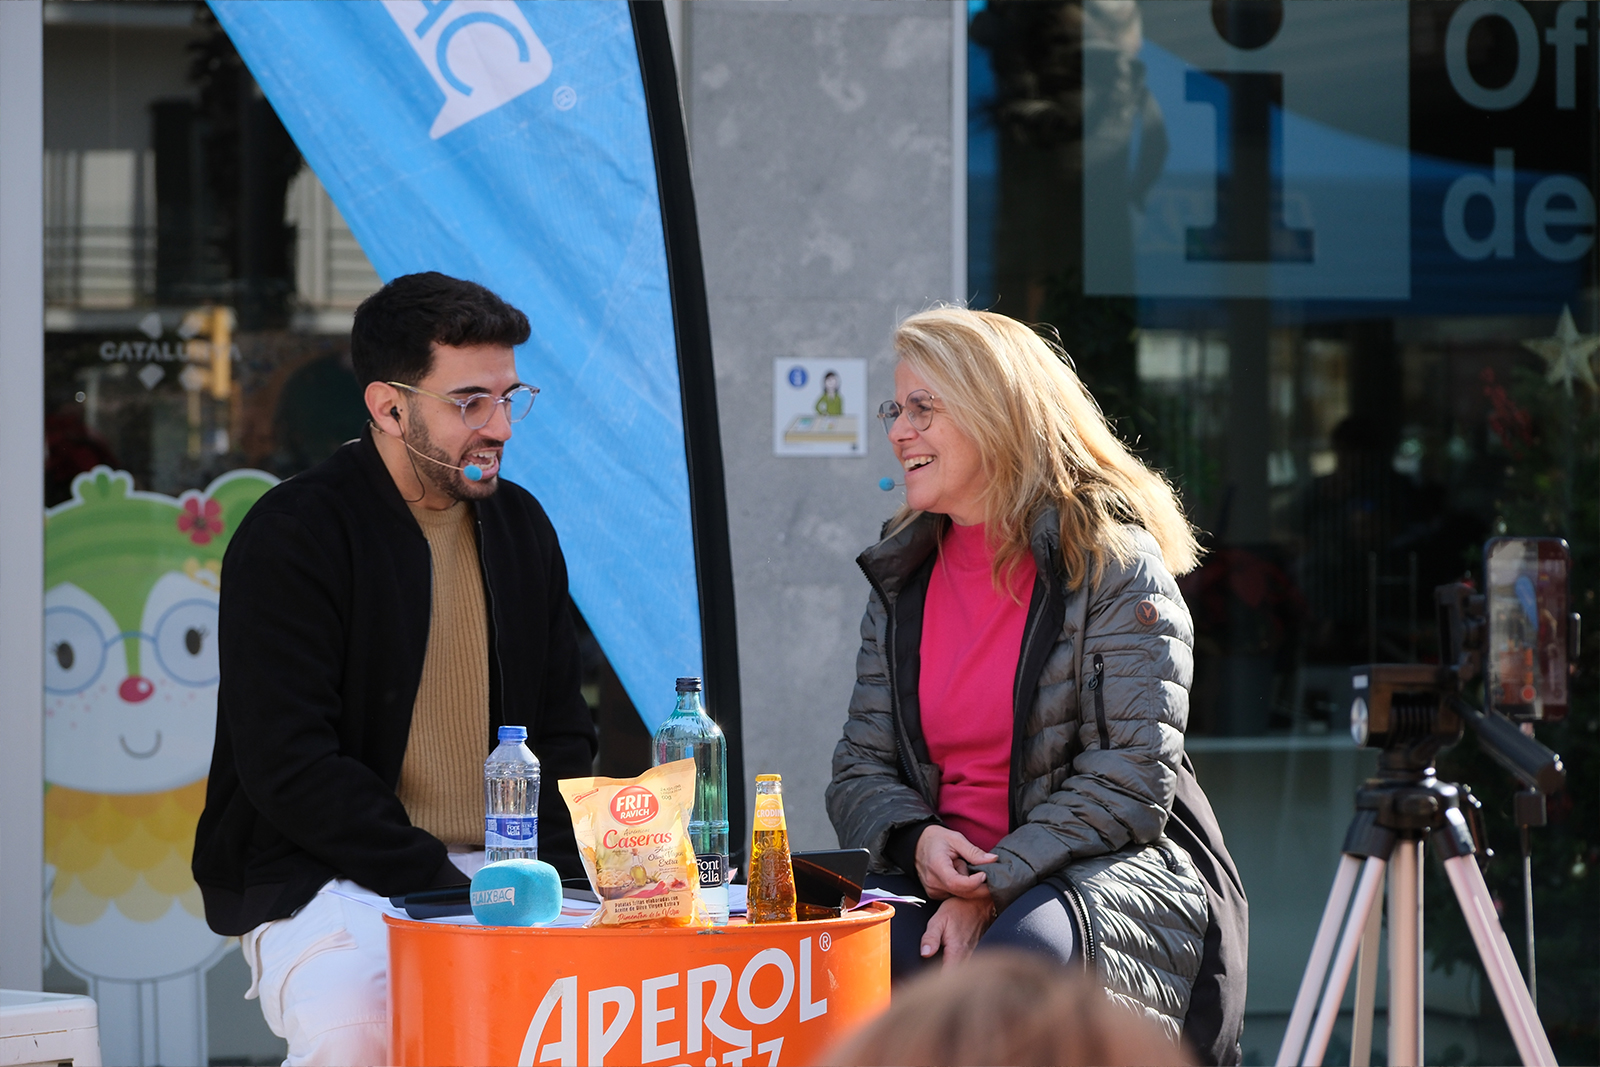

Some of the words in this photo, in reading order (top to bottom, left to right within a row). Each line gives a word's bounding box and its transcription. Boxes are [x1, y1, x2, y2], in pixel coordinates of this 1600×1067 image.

[1445, 0, 1588, 111] Of
[1442, 148, 1597, 262] de
[616, 794, 652, 812] FRIT
[620, 808, 650, 819] RAVICH
[756, 809, 785, 818] CRODIN
[602, 829, 672, 850] Caseras
[472, 888, 513, 904] FLAIXBAC
[517, 936, 828, 1067] APEROL
